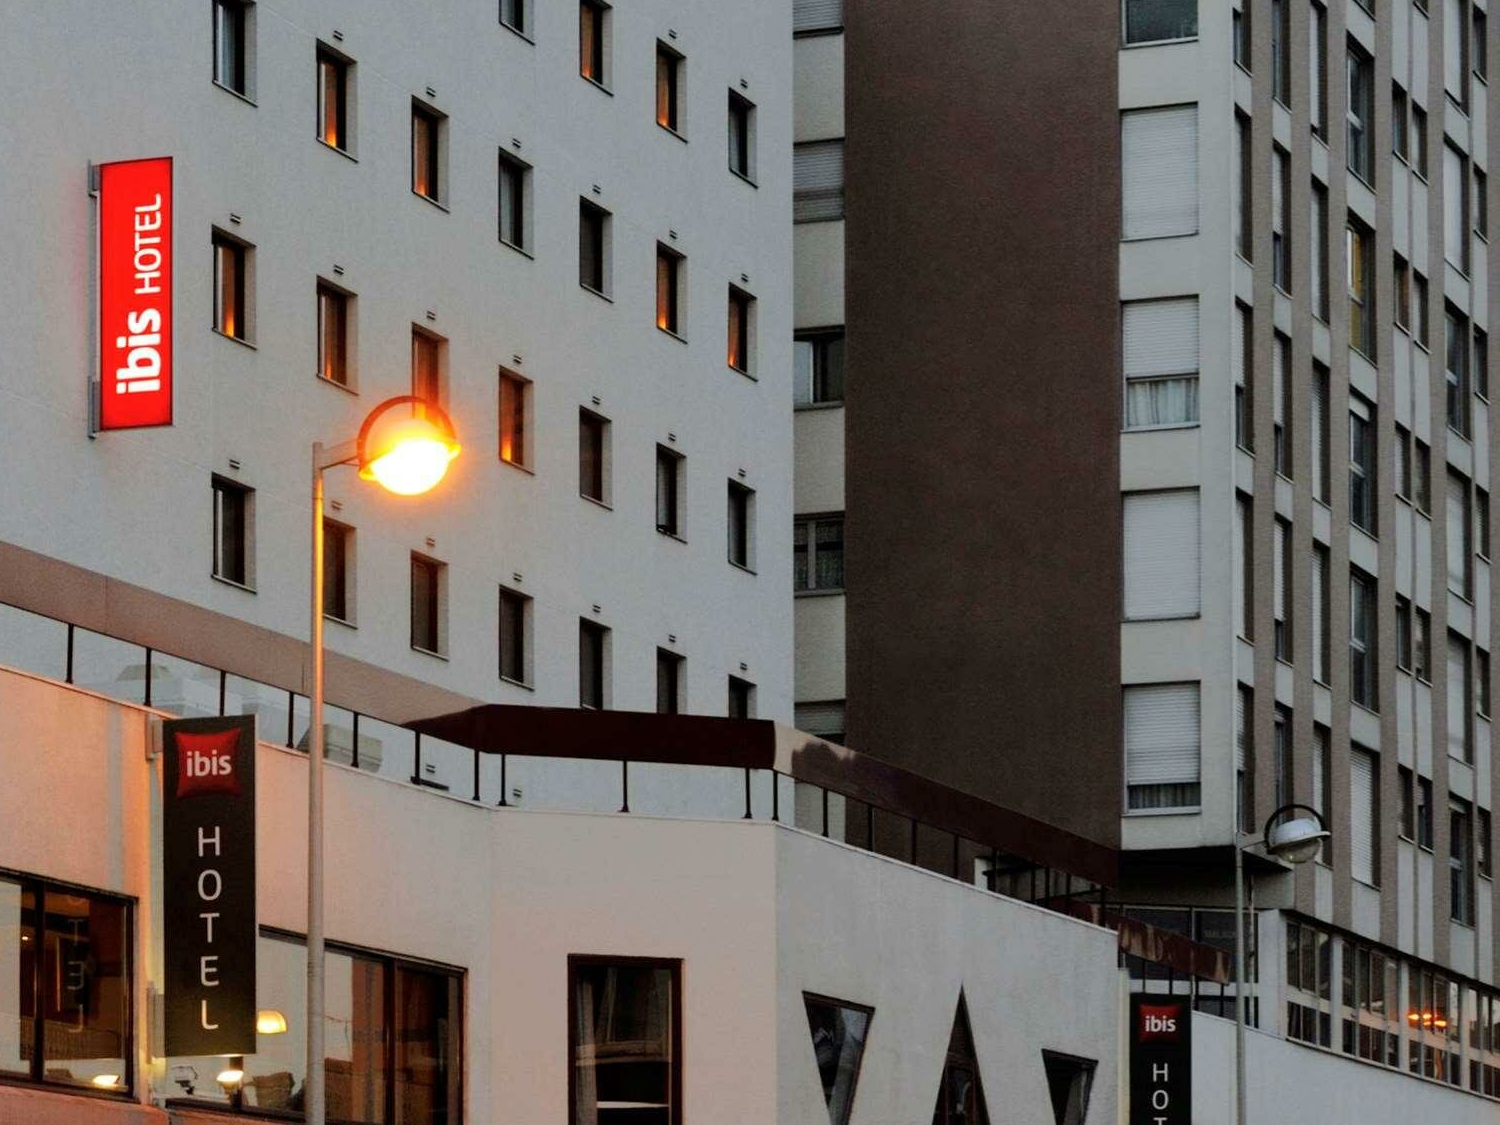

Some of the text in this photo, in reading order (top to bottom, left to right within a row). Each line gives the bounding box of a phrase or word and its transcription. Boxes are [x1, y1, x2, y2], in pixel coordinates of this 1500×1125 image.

[116, 193, 162, 394] ibis HOTEL
[185, 749, 233, 777] ibis
[198, 826, 222, 1030] HOTEL
[1144, 1015, 1177, 1033] ibis
